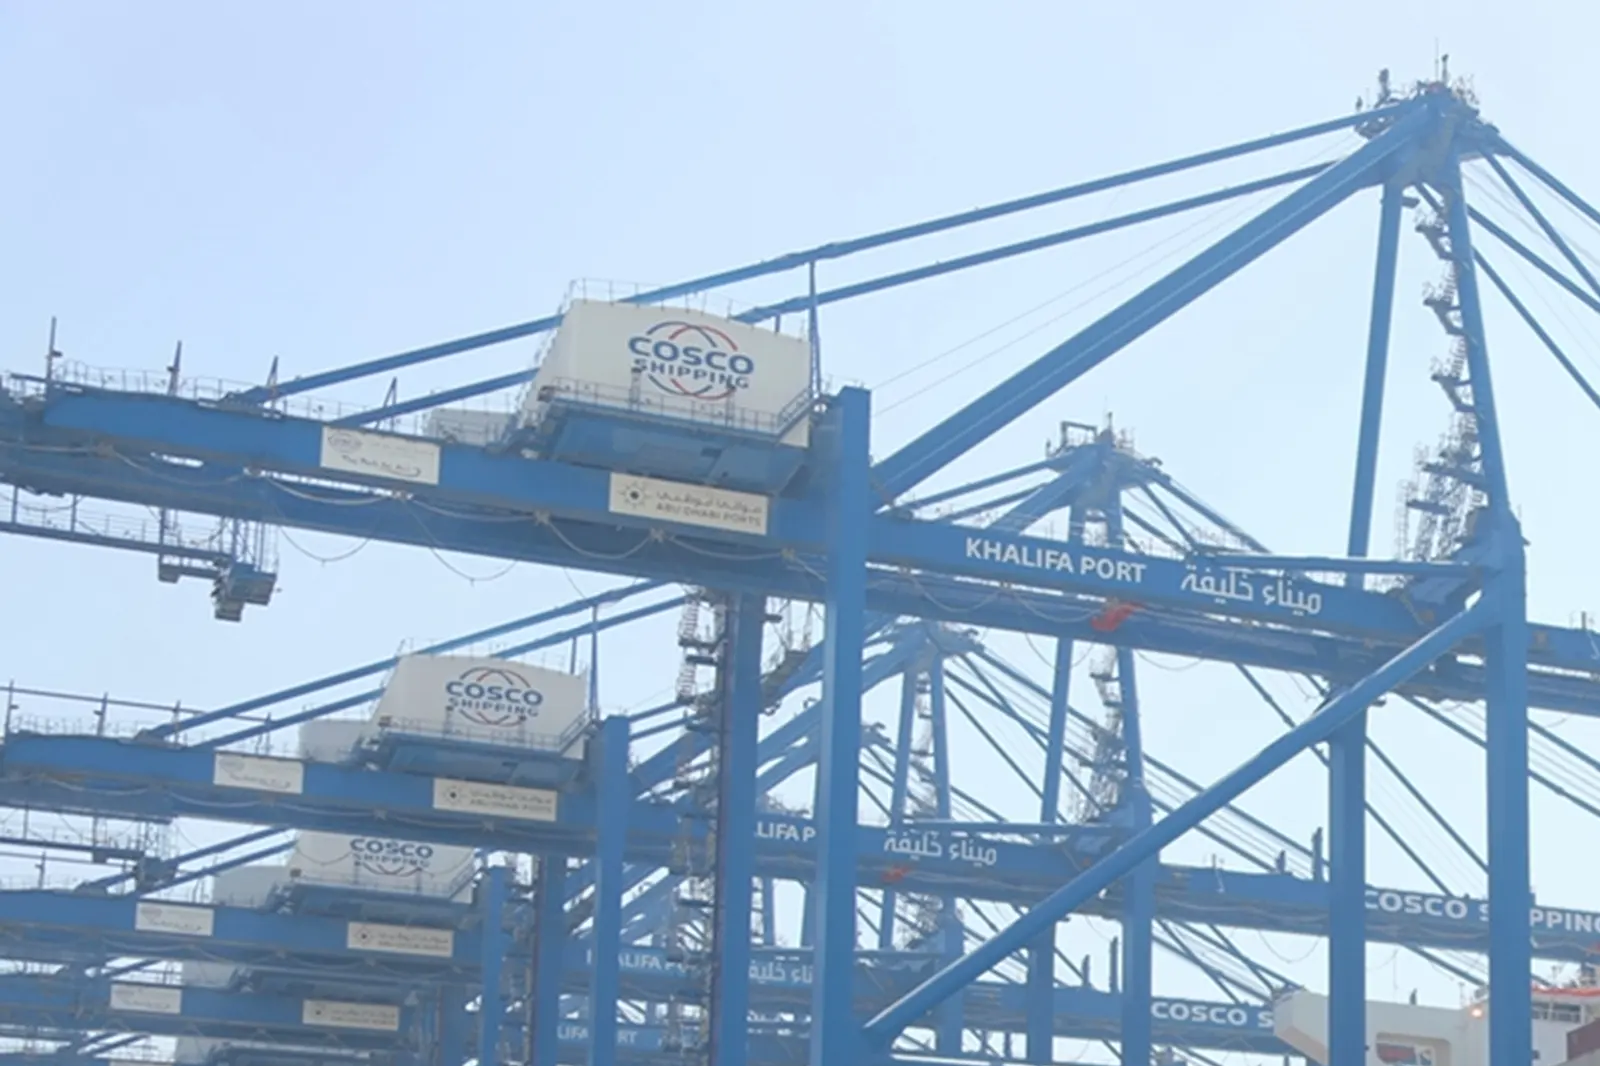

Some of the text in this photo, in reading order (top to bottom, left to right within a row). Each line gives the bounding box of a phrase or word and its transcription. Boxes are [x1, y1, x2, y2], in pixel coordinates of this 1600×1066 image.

[628, 336, 754, 375] COSCO
[633, 358, 749, 389] SHIPPING
[965, 537, 1147, 584] KHALIFA PORT
[1180, 563, 1322, 616] ميناء خليفة
[446, 681, 543, 706] COSCO
[448, 697, 540, 717] SHIPPING
[754, 821, 799, 841] LIFA
[350, 838, 433, 859] COSCO
[1364, 889, 1468, 919] COSCO
[1150, 1001, 1248, 1026] COSCO
